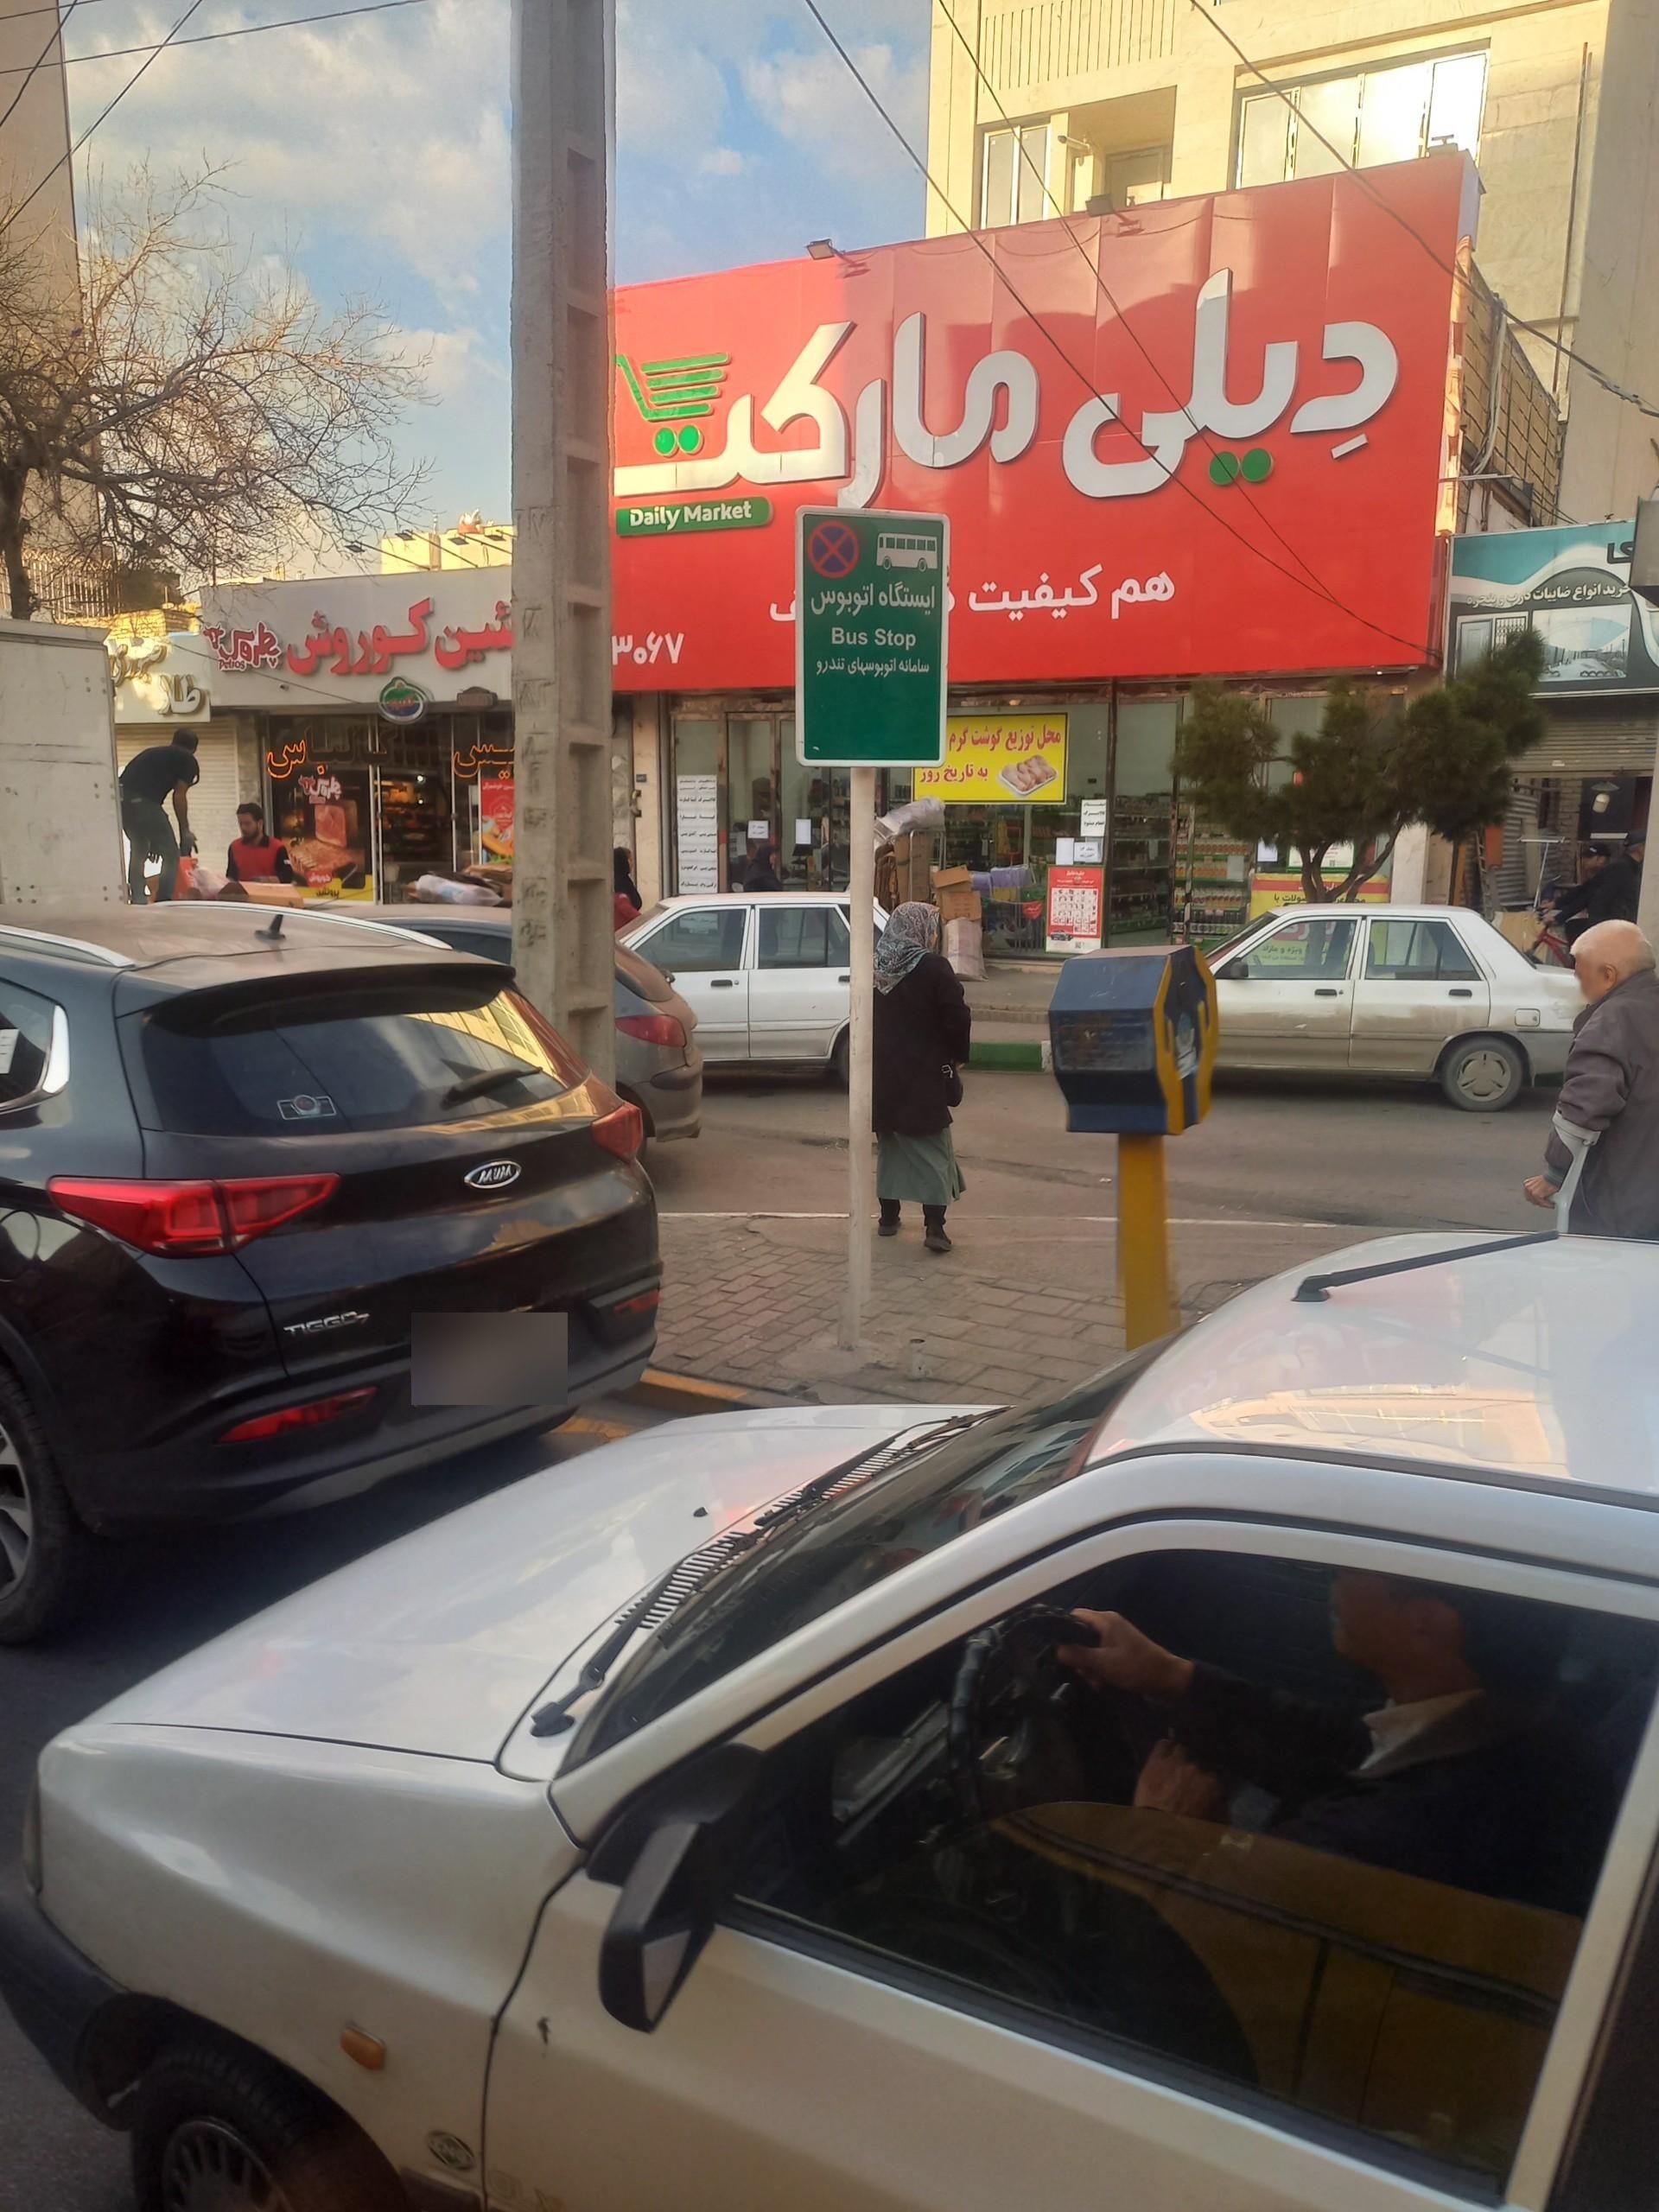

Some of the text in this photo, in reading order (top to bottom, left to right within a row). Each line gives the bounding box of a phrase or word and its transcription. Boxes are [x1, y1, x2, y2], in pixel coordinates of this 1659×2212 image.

[629, 500, 752, 531] Daily Market
[810, 582, 874, 617] اتوبوس
[878, 581, 936, 616] ایستگاه
[968, 563, 1103, 622] کیفیت
[1110, 570, 1176, 620] هم
[1573, 582, 1601, 601] انواع
[286, 596, 433, 677] کوروش
[831, 626, 917, 651] Bus Stop
[816, 657, 845, 676] تندرو
[898, 658, 930, 674] سامانه
[1005, 725, 1035, 752] توزیع
[1037, 724, 1062, 750] محل
[943, 763, 974, 783] تاریخ
[977, 766, 988, 782] به
